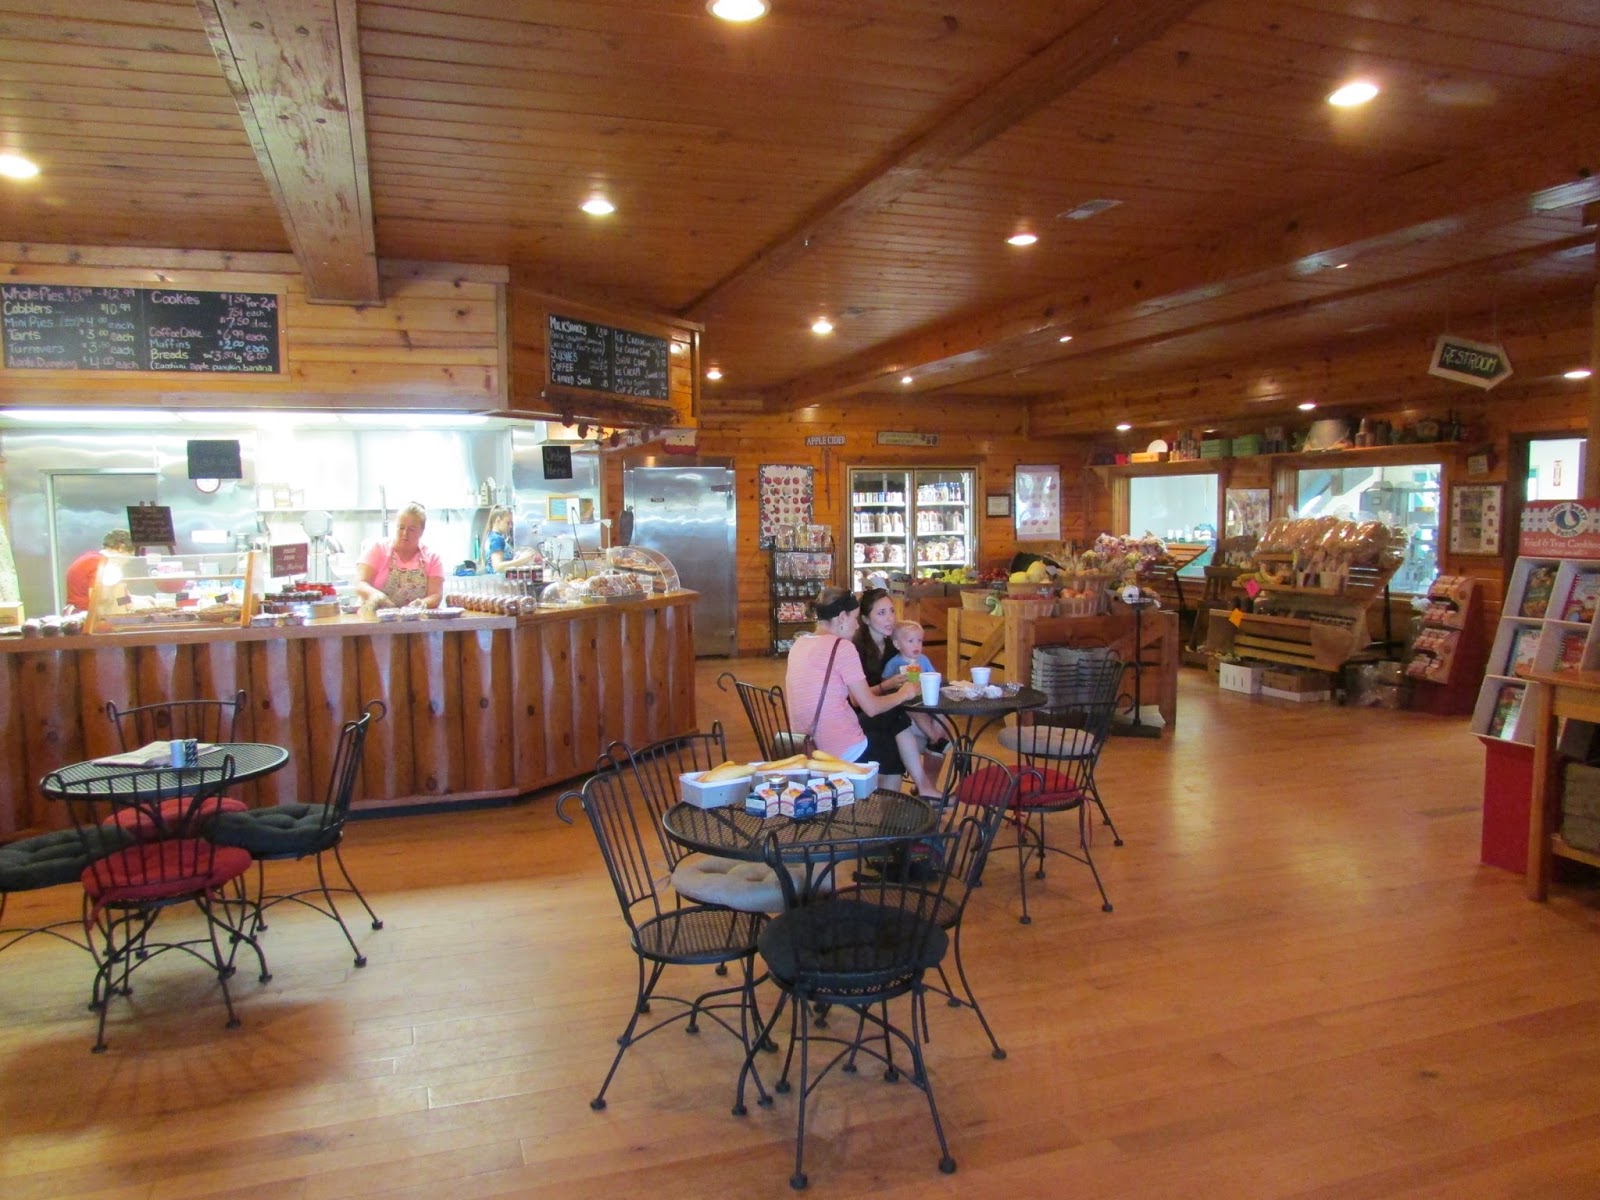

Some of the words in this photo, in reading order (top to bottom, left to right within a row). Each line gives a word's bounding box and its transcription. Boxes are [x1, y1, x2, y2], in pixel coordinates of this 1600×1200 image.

[151, 291, 200, 305] Cookies
[4, 301, 53, 315] Cobblers
[246, 309, 264, 317] each
[7, 329, 41, 341] Tarts
[110, 332, 135, 342] each
[110, 346, 136, 356] each
[150, 338, 191, 349] Muffins
[245, 345, 270, 354] each
[150, 348, 188, 360] Breads
[1443, 347, 1497, 372] RESTROOM
[551, 359, 575, 373] COFFEE
[806, 437, 827, 445] APPLE
[827, 435, 845, 444] CIDER
